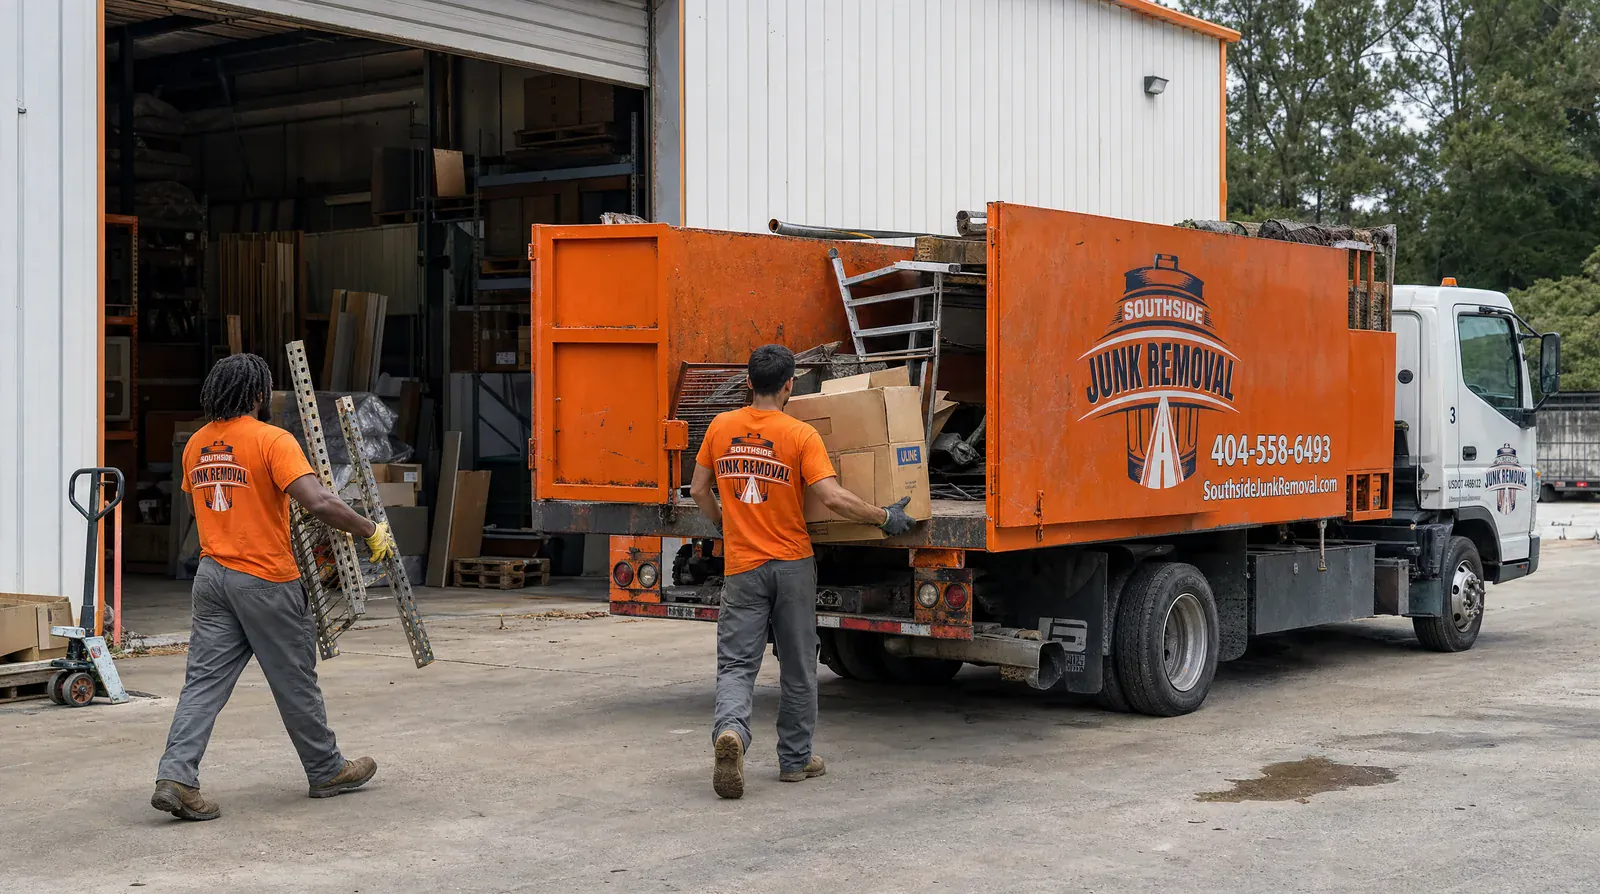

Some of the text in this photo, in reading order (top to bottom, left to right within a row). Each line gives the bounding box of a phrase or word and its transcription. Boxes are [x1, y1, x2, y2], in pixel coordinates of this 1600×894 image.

[1123, 298, 1203, 325] SOUTHSIDE
[1086, 342, 1235, 404] JUNK REMOVAL
[1449, 406, 1456, 424] 3
[730, 446, 773, 457] SOUTHSIDE
[900, 449, 918, 463] ULINE
[1210, 434, 1331, 466] 404-558-6493
[210, 467, 248, 484] REMOVAL
[743, 459, 791, 482] REMOVAL
[1484, 468, 1527, 488] JUNK REMOVAL
[1203, 475, 1338, 501] SouthsideJunkRemoval.com
[1447, 479, 1464, 489] USDOT
